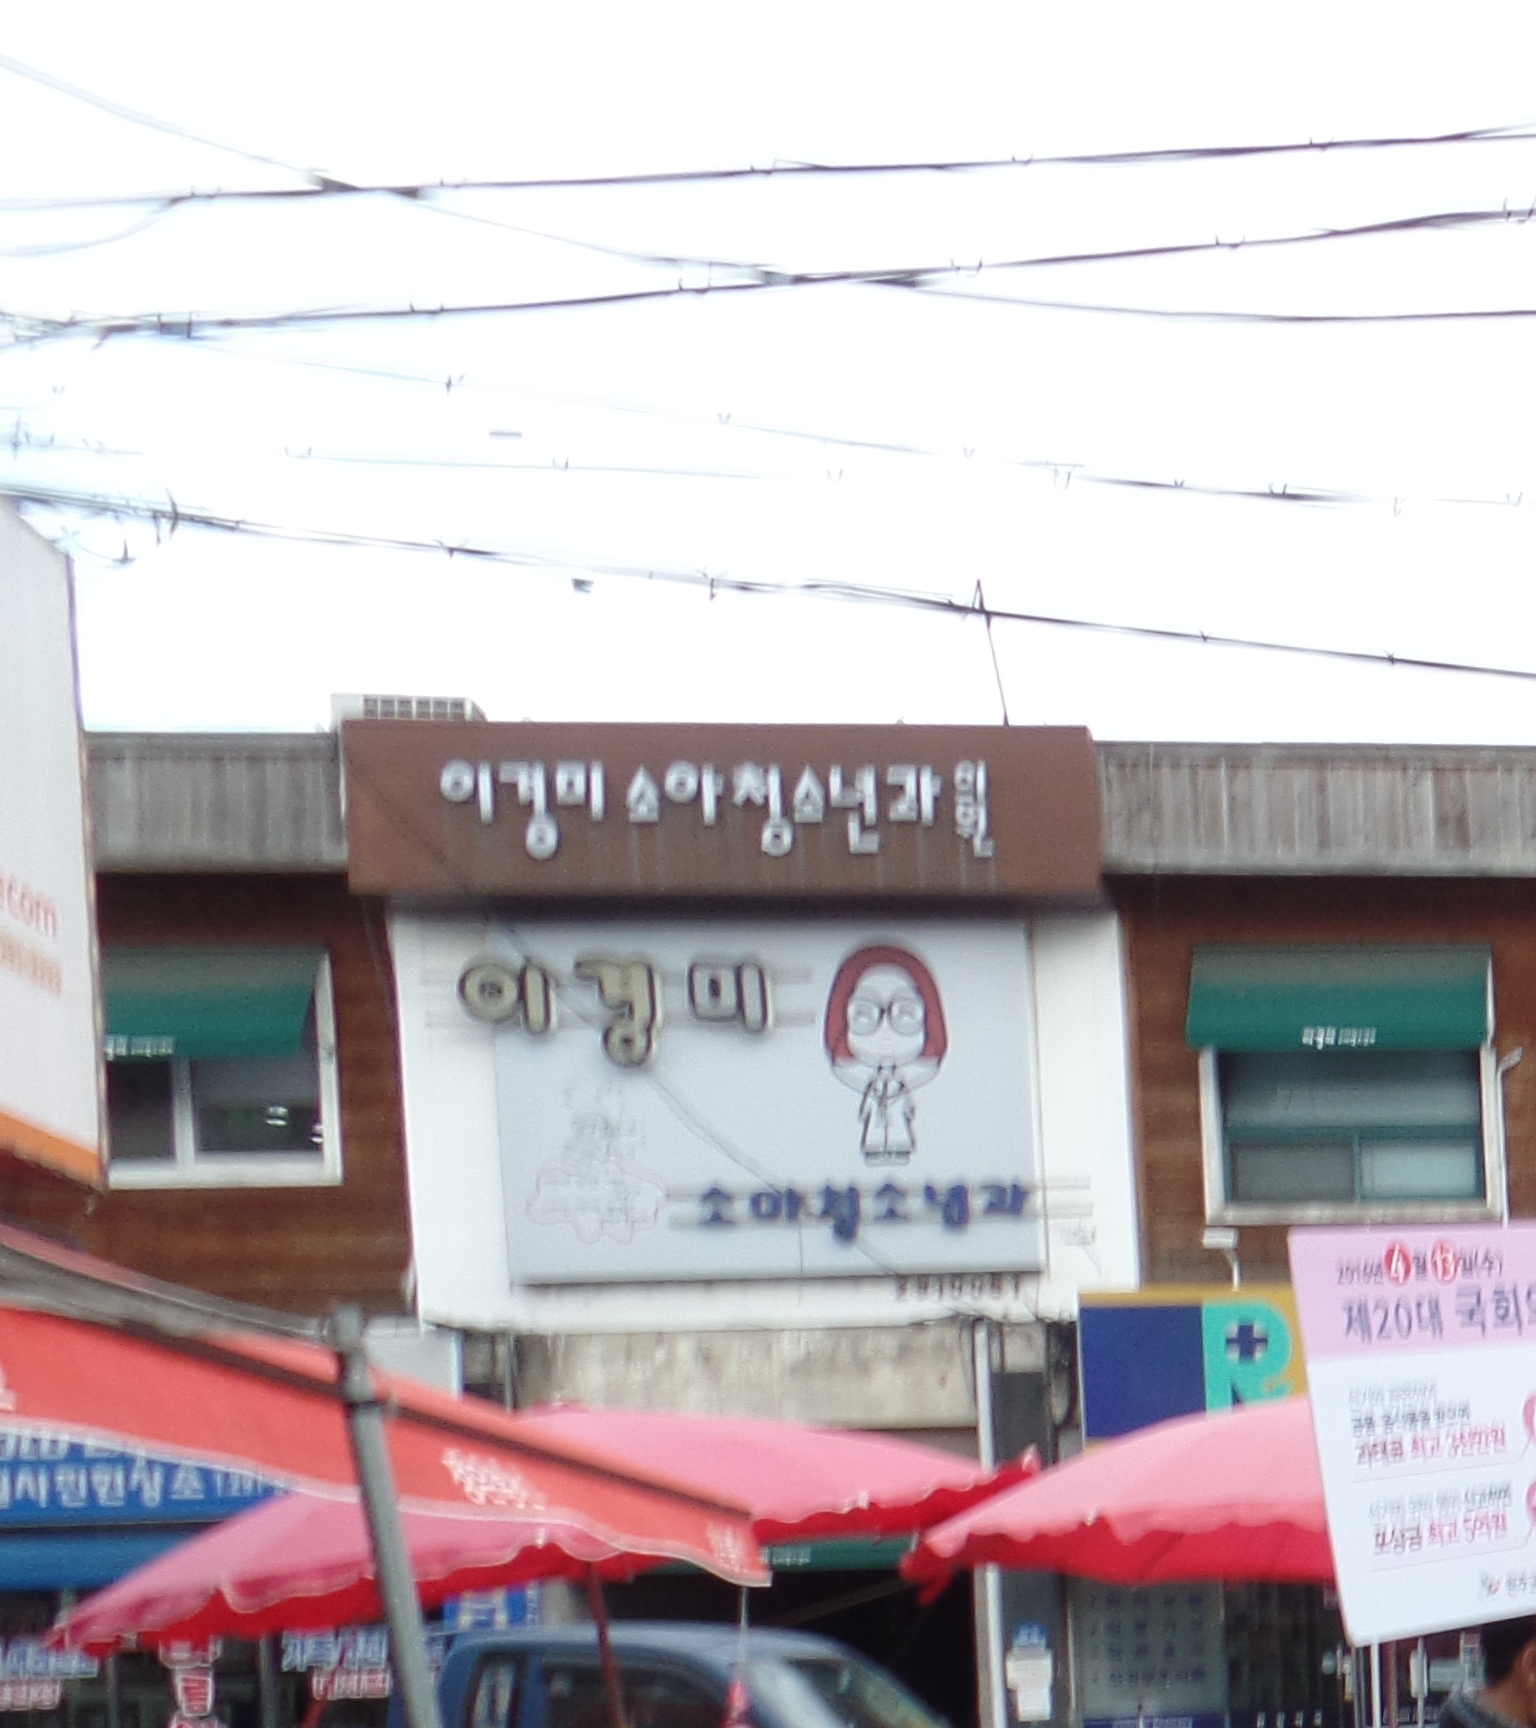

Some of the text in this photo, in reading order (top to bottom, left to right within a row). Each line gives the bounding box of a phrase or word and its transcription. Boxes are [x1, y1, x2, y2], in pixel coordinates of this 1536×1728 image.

[440, 757, 606, 860] 이경미
[458, 958, 772, 1068] 이경미
[698, 1178, 1030, 1243] 소아청소년과
[1343, 1293, 1444, 1343] 제20대
